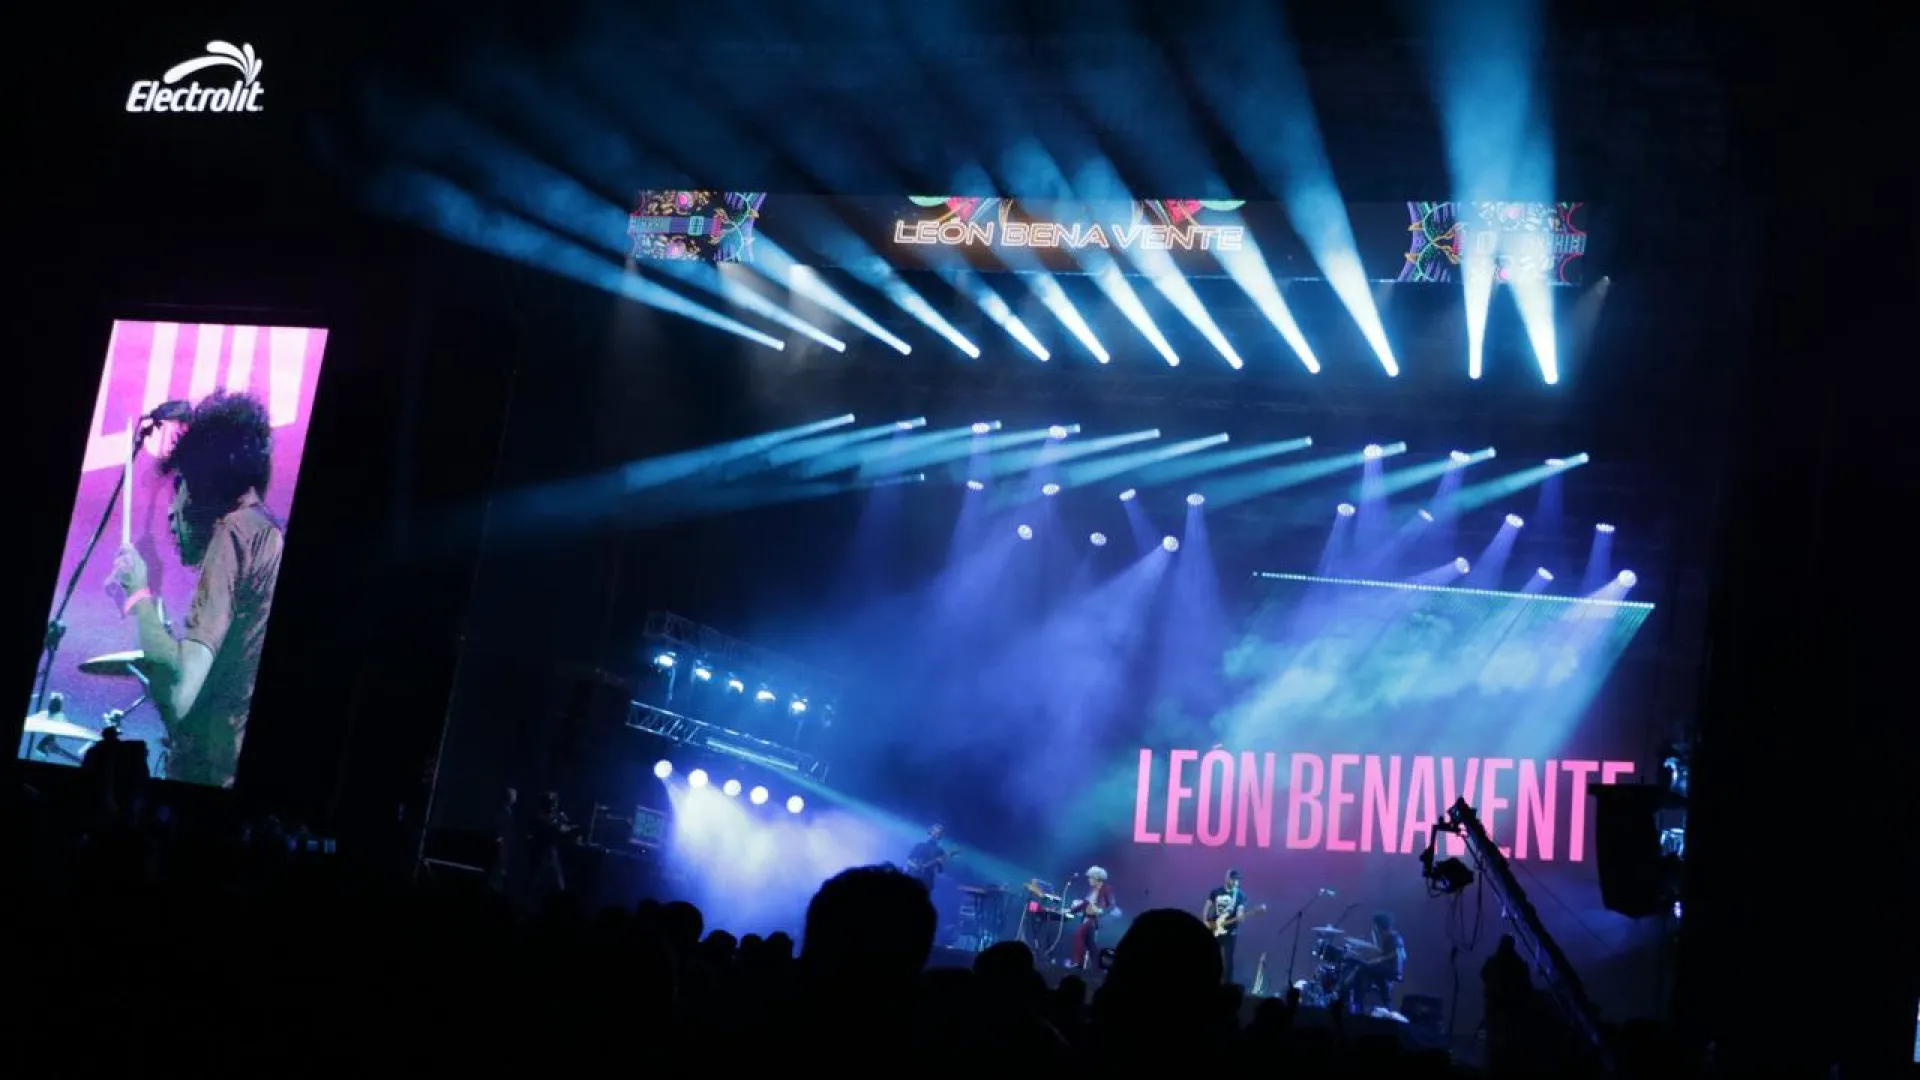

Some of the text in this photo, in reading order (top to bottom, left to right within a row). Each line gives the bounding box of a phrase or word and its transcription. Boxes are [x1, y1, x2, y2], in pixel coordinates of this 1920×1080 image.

[125, 80, 264, 112] Electrolit
[893, 217, 995, 246] LEÓN
[1133, 743, 1635, 863] LEÓN BENAVENT
